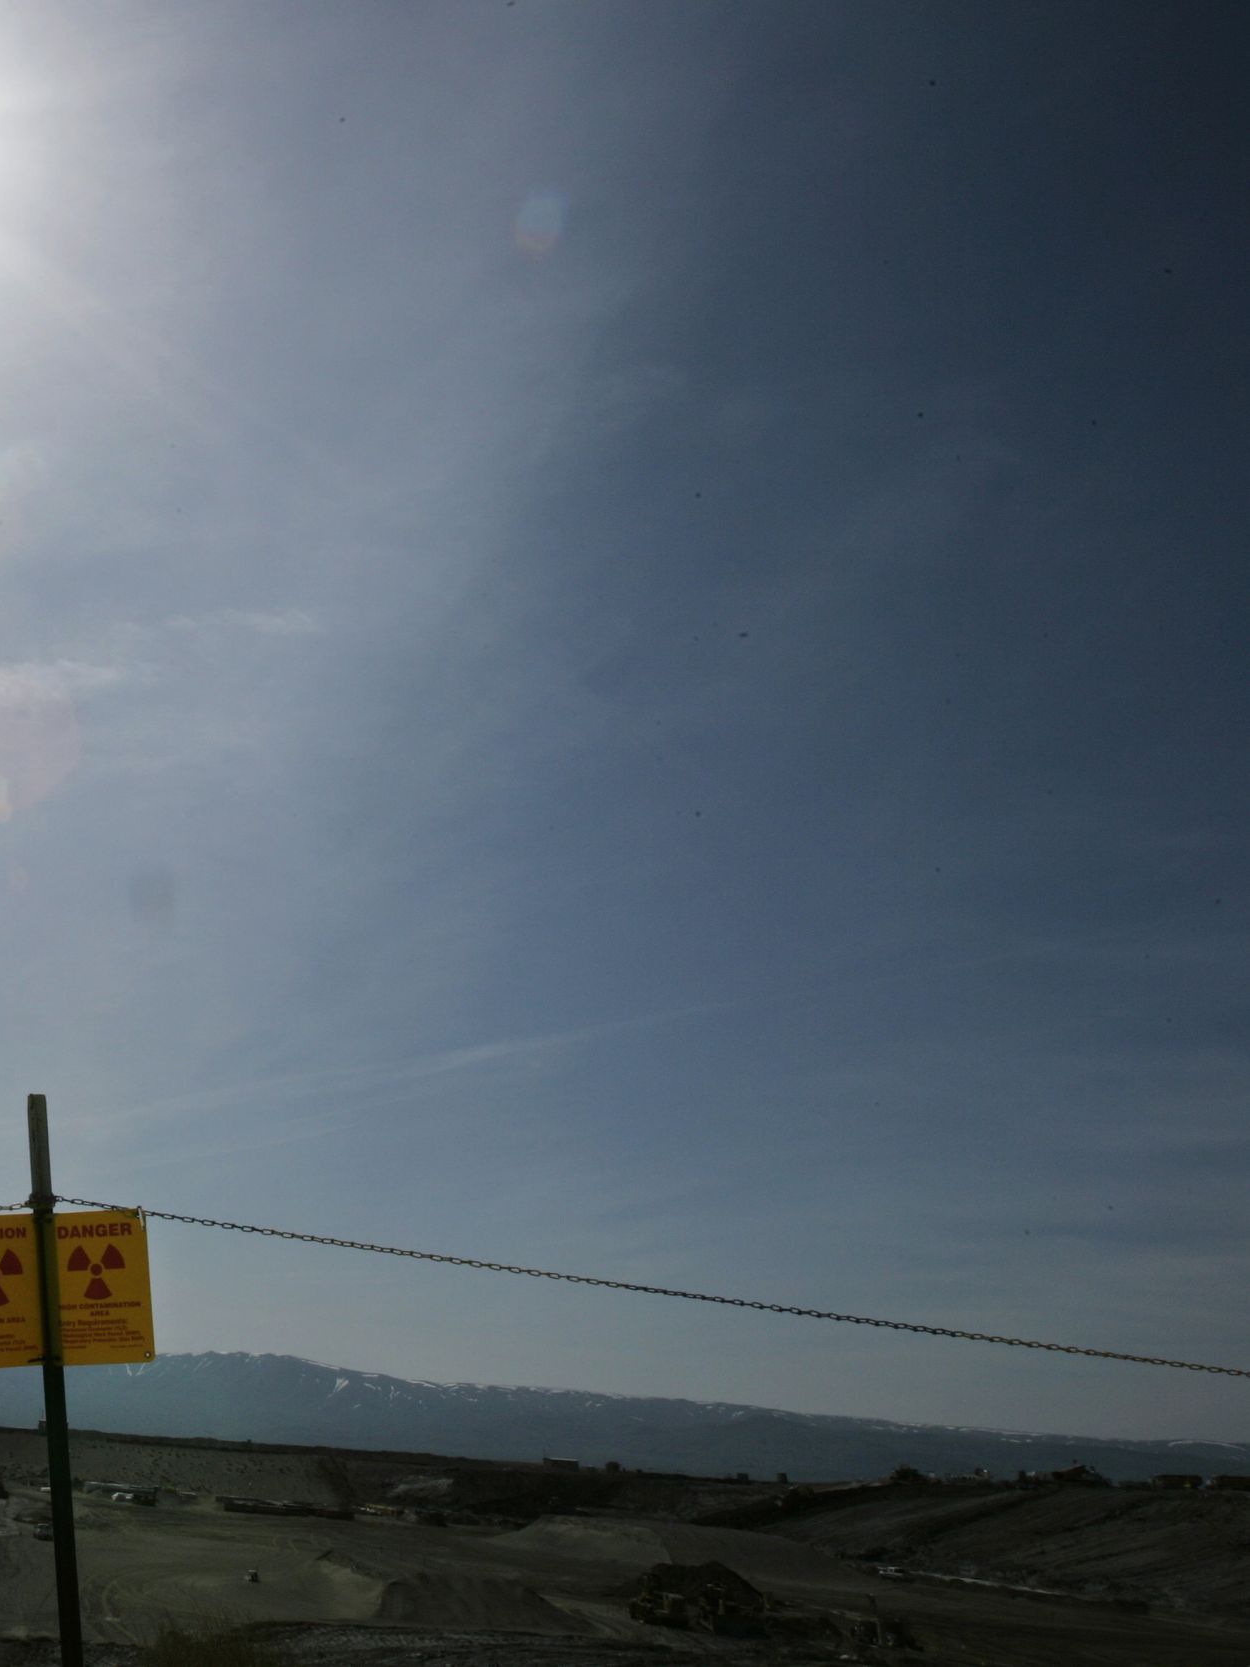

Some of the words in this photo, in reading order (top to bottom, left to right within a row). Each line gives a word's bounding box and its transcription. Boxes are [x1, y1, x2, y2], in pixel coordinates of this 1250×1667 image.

[56, 1222, 133, 1240] DANGER
[78, 1301, 142, 1310] CONTAMINATION
[6, 1315, 26, 1324] AREA
